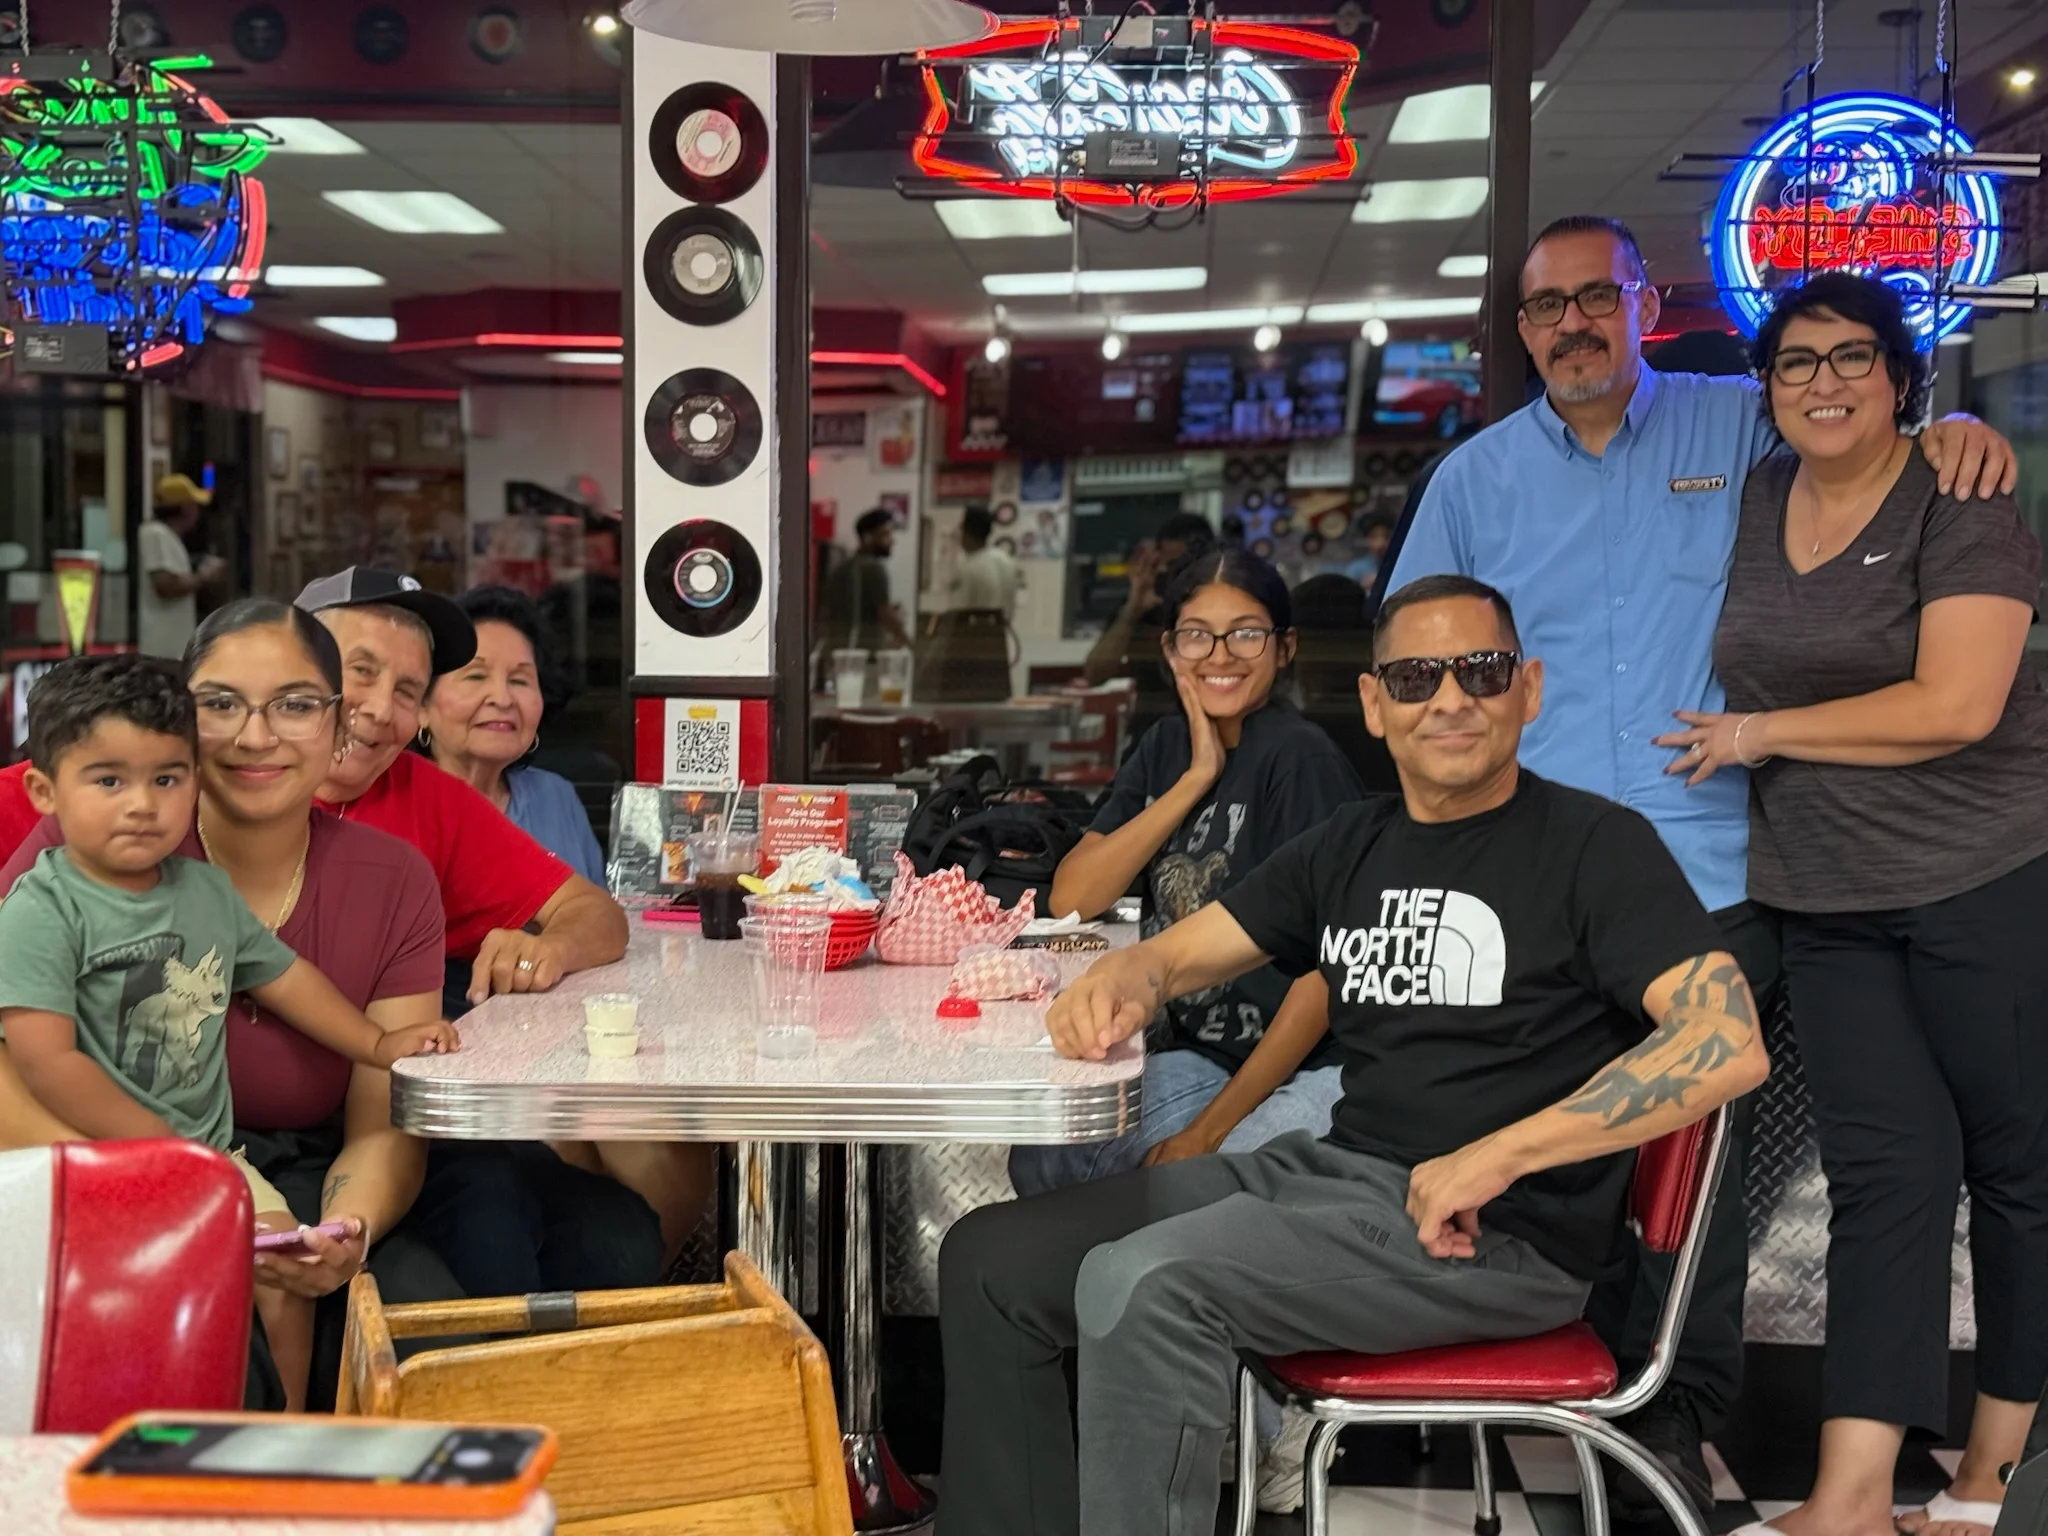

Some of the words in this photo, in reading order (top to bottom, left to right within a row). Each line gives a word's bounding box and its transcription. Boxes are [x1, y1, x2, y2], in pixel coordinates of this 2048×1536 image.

[767, 817, 799, 828] Loyalty
[809, 808, 826, 817] Our
[1379, 888, 1444, 928] THE
[1319, 924, 1436, 967] NORTH
[1341, 964, 1431, 1006] FACE
